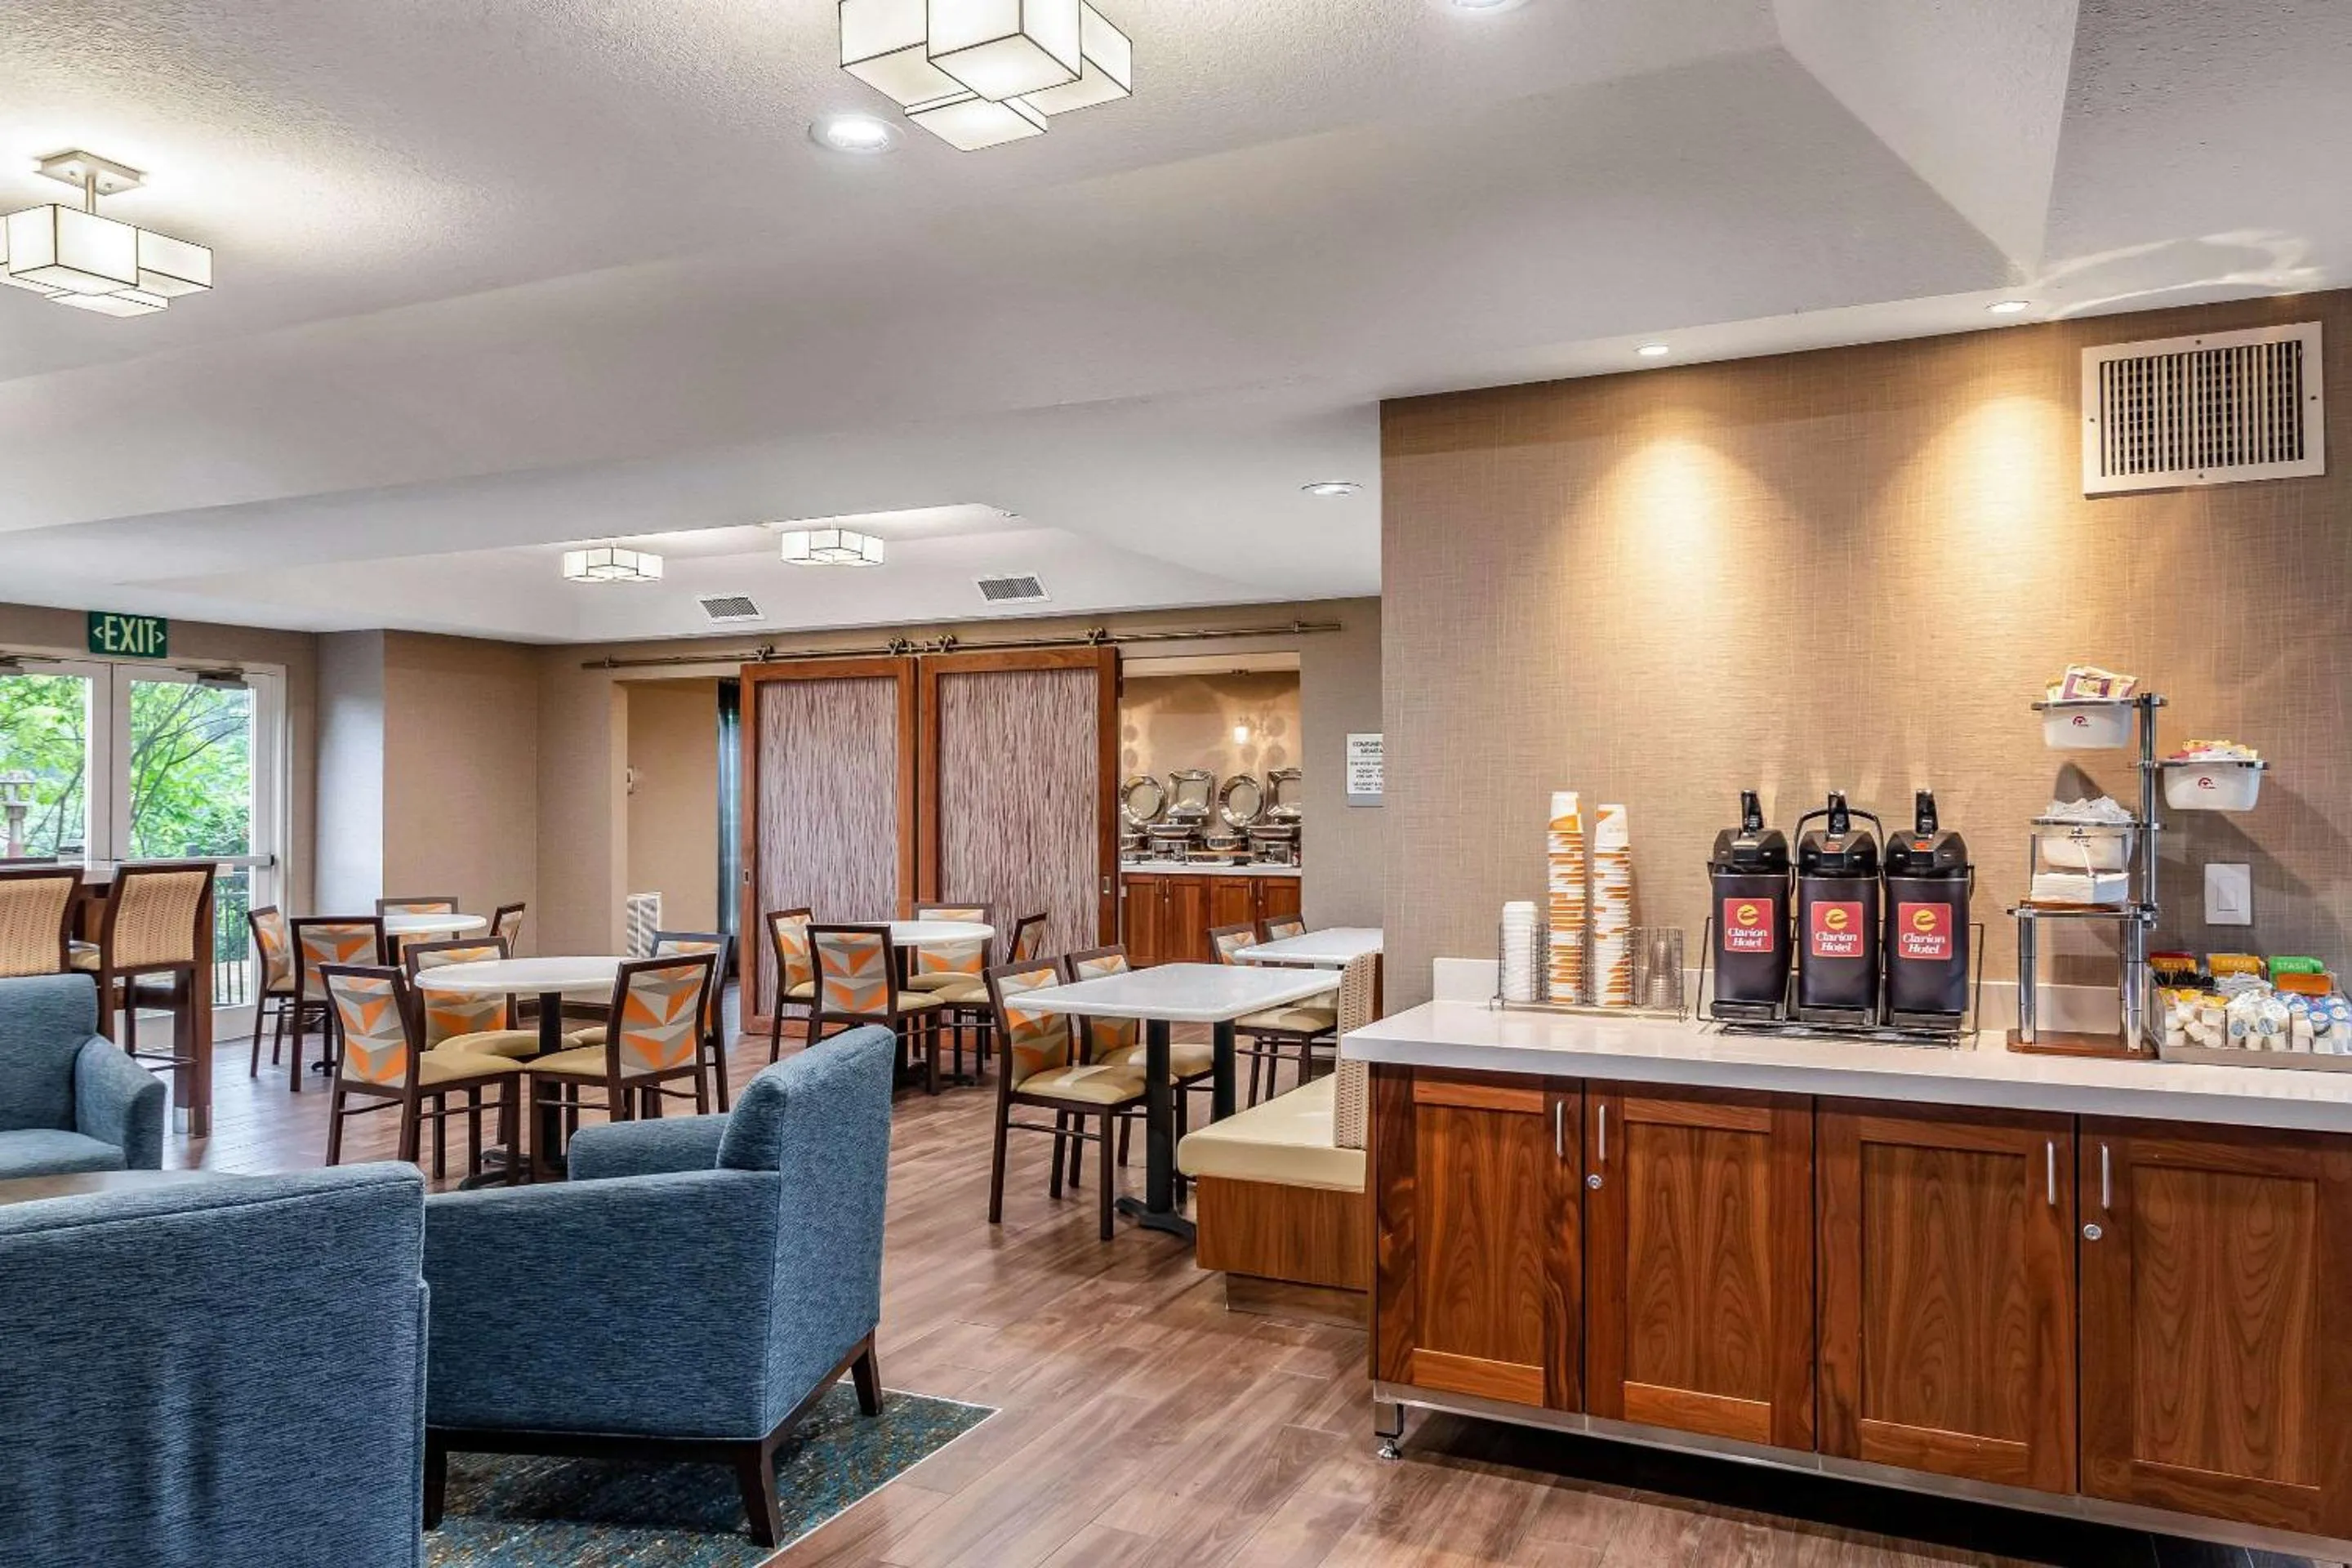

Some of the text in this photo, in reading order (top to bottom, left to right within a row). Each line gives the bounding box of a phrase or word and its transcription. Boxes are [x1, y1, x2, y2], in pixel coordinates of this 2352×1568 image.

[105, 616, 157, 653] EXIT
[1727, 928, 1768, 937] Clarion
[1815, 931, 1857, 942] Clarion
[1732, 938, 1762, 947] Hotel
[1903, 933, 1945, 943] Clarion
[1821, 942, 1851, 952] Hotel
[1907, 943, 1940, 954] Hotel
[2277, 961, 2307, 970] STASH
